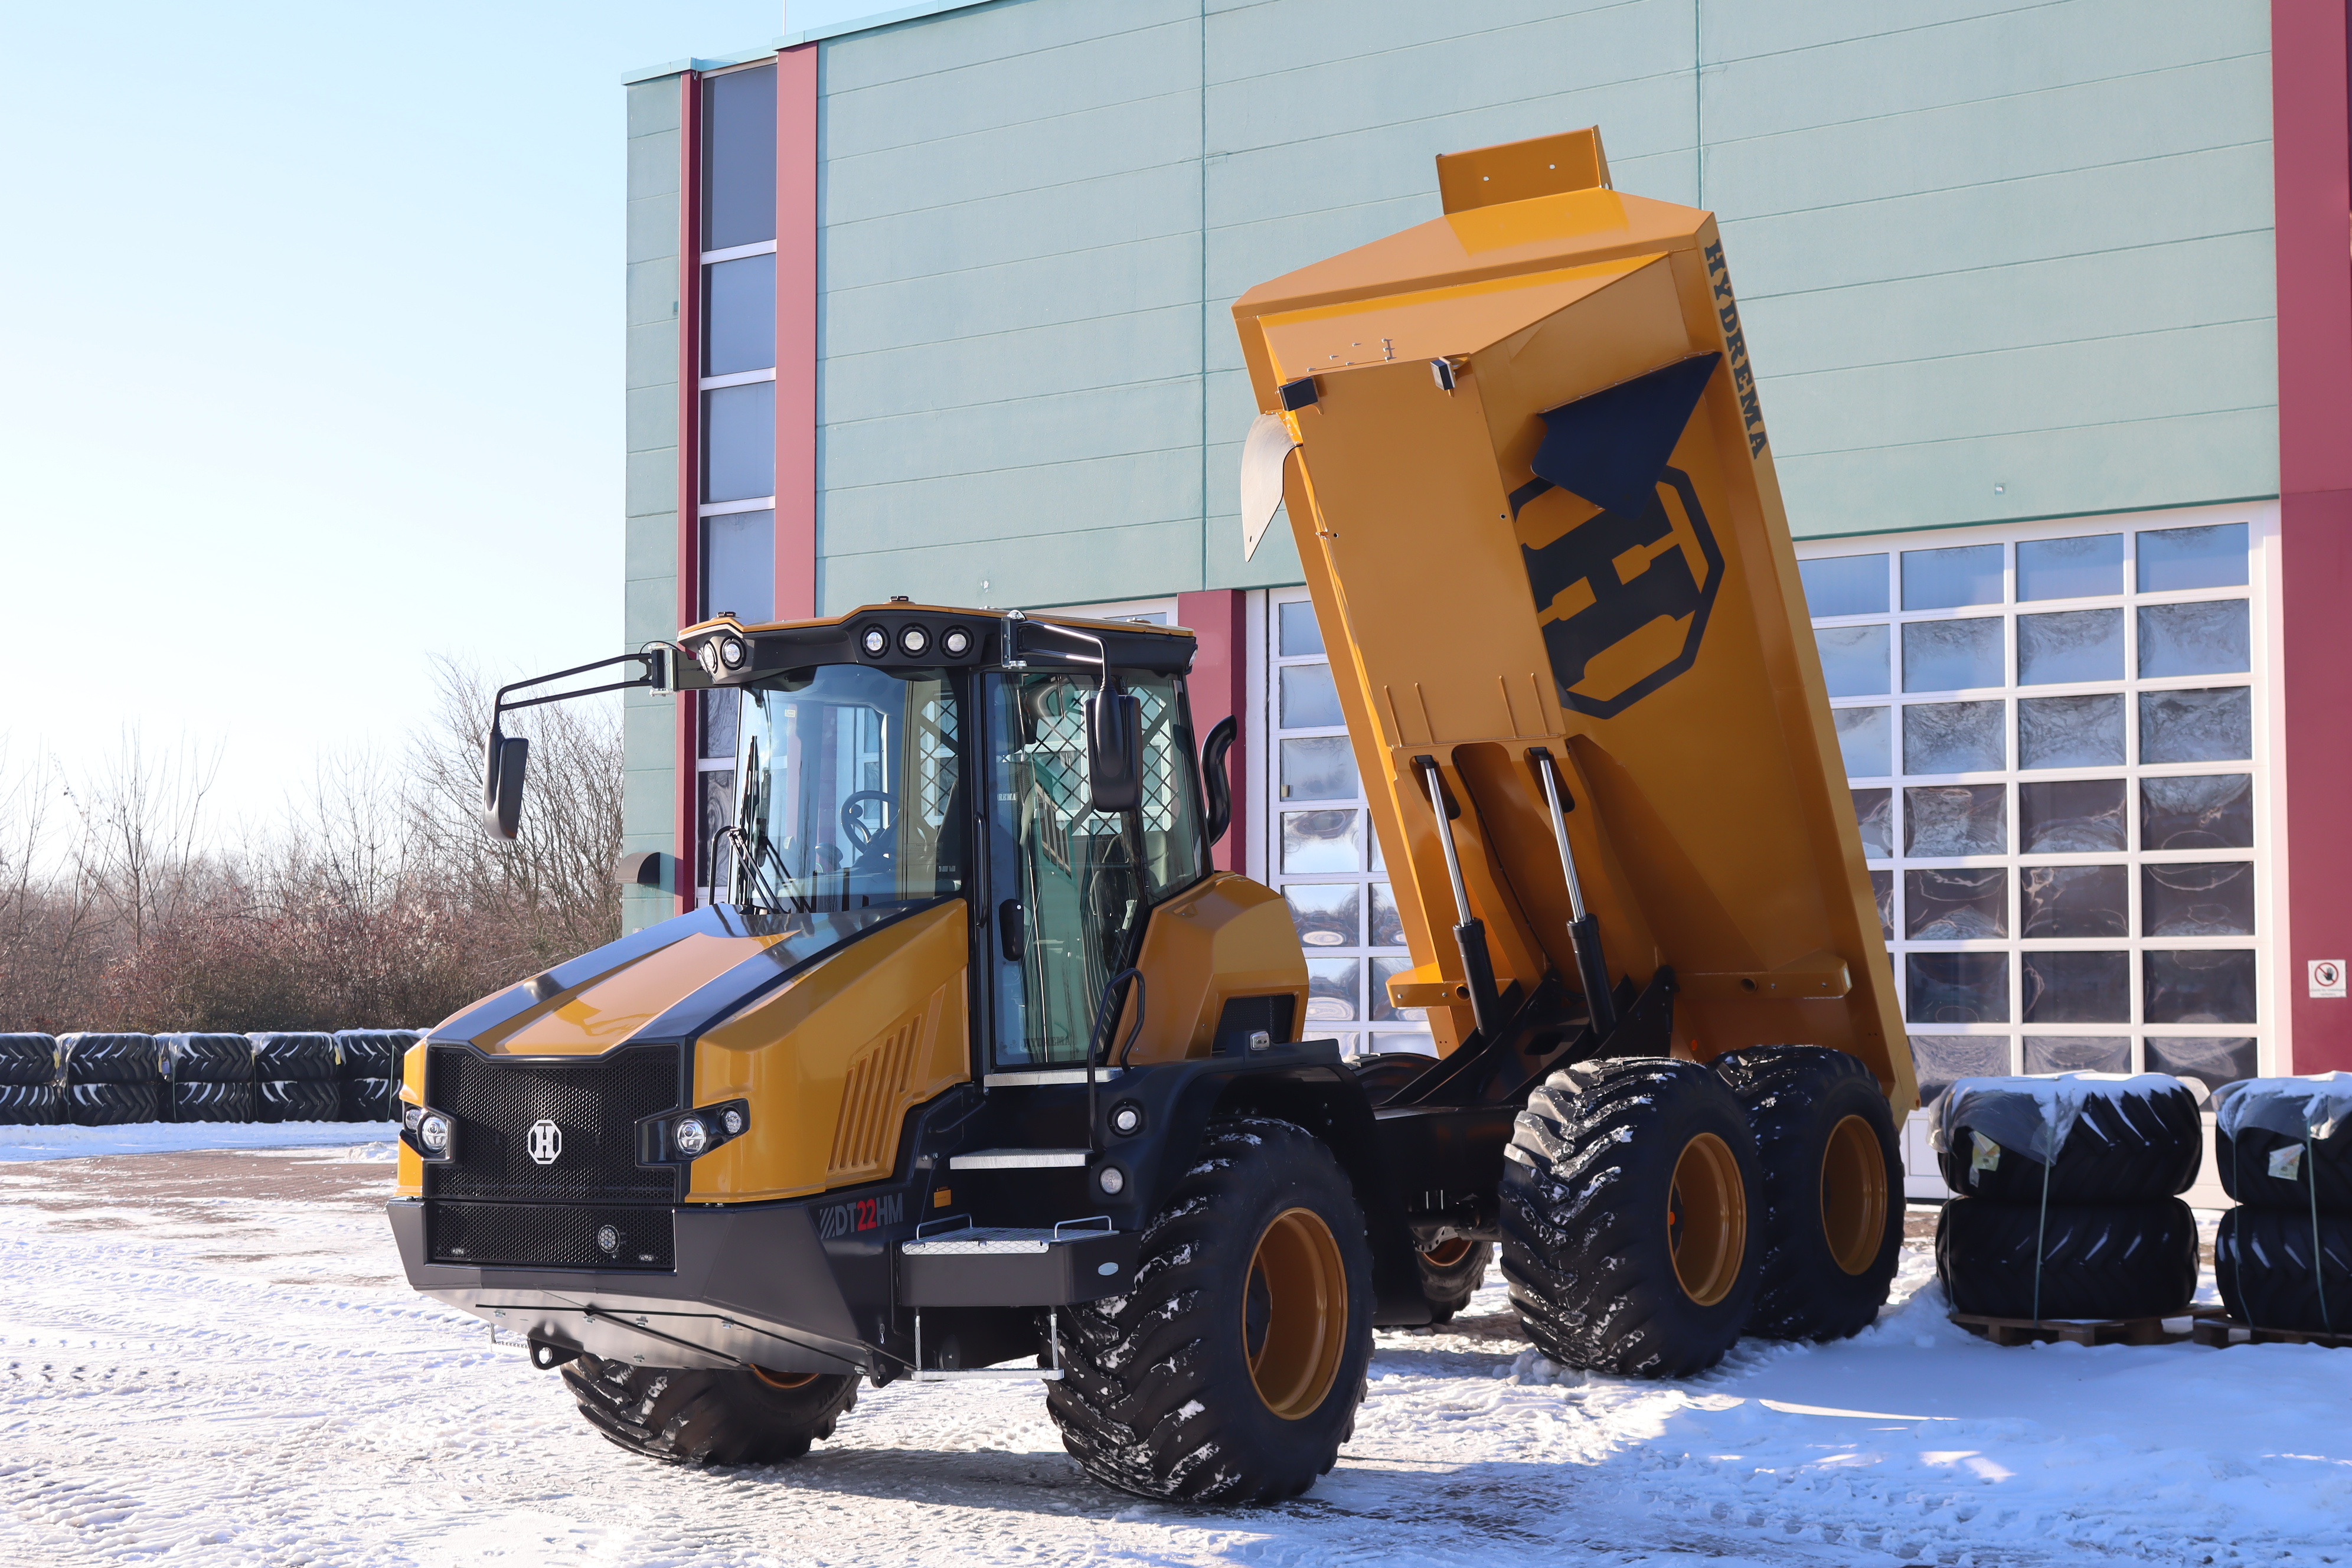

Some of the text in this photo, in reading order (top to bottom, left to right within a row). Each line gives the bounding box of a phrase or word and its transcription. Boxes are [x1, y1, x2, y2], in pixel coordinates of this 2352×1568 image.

[1704, 238, 1767, 460] HYDREMA
[997, 793, 1016, 801] REMA
[834, 1193, 903, 1236] DT22HM
